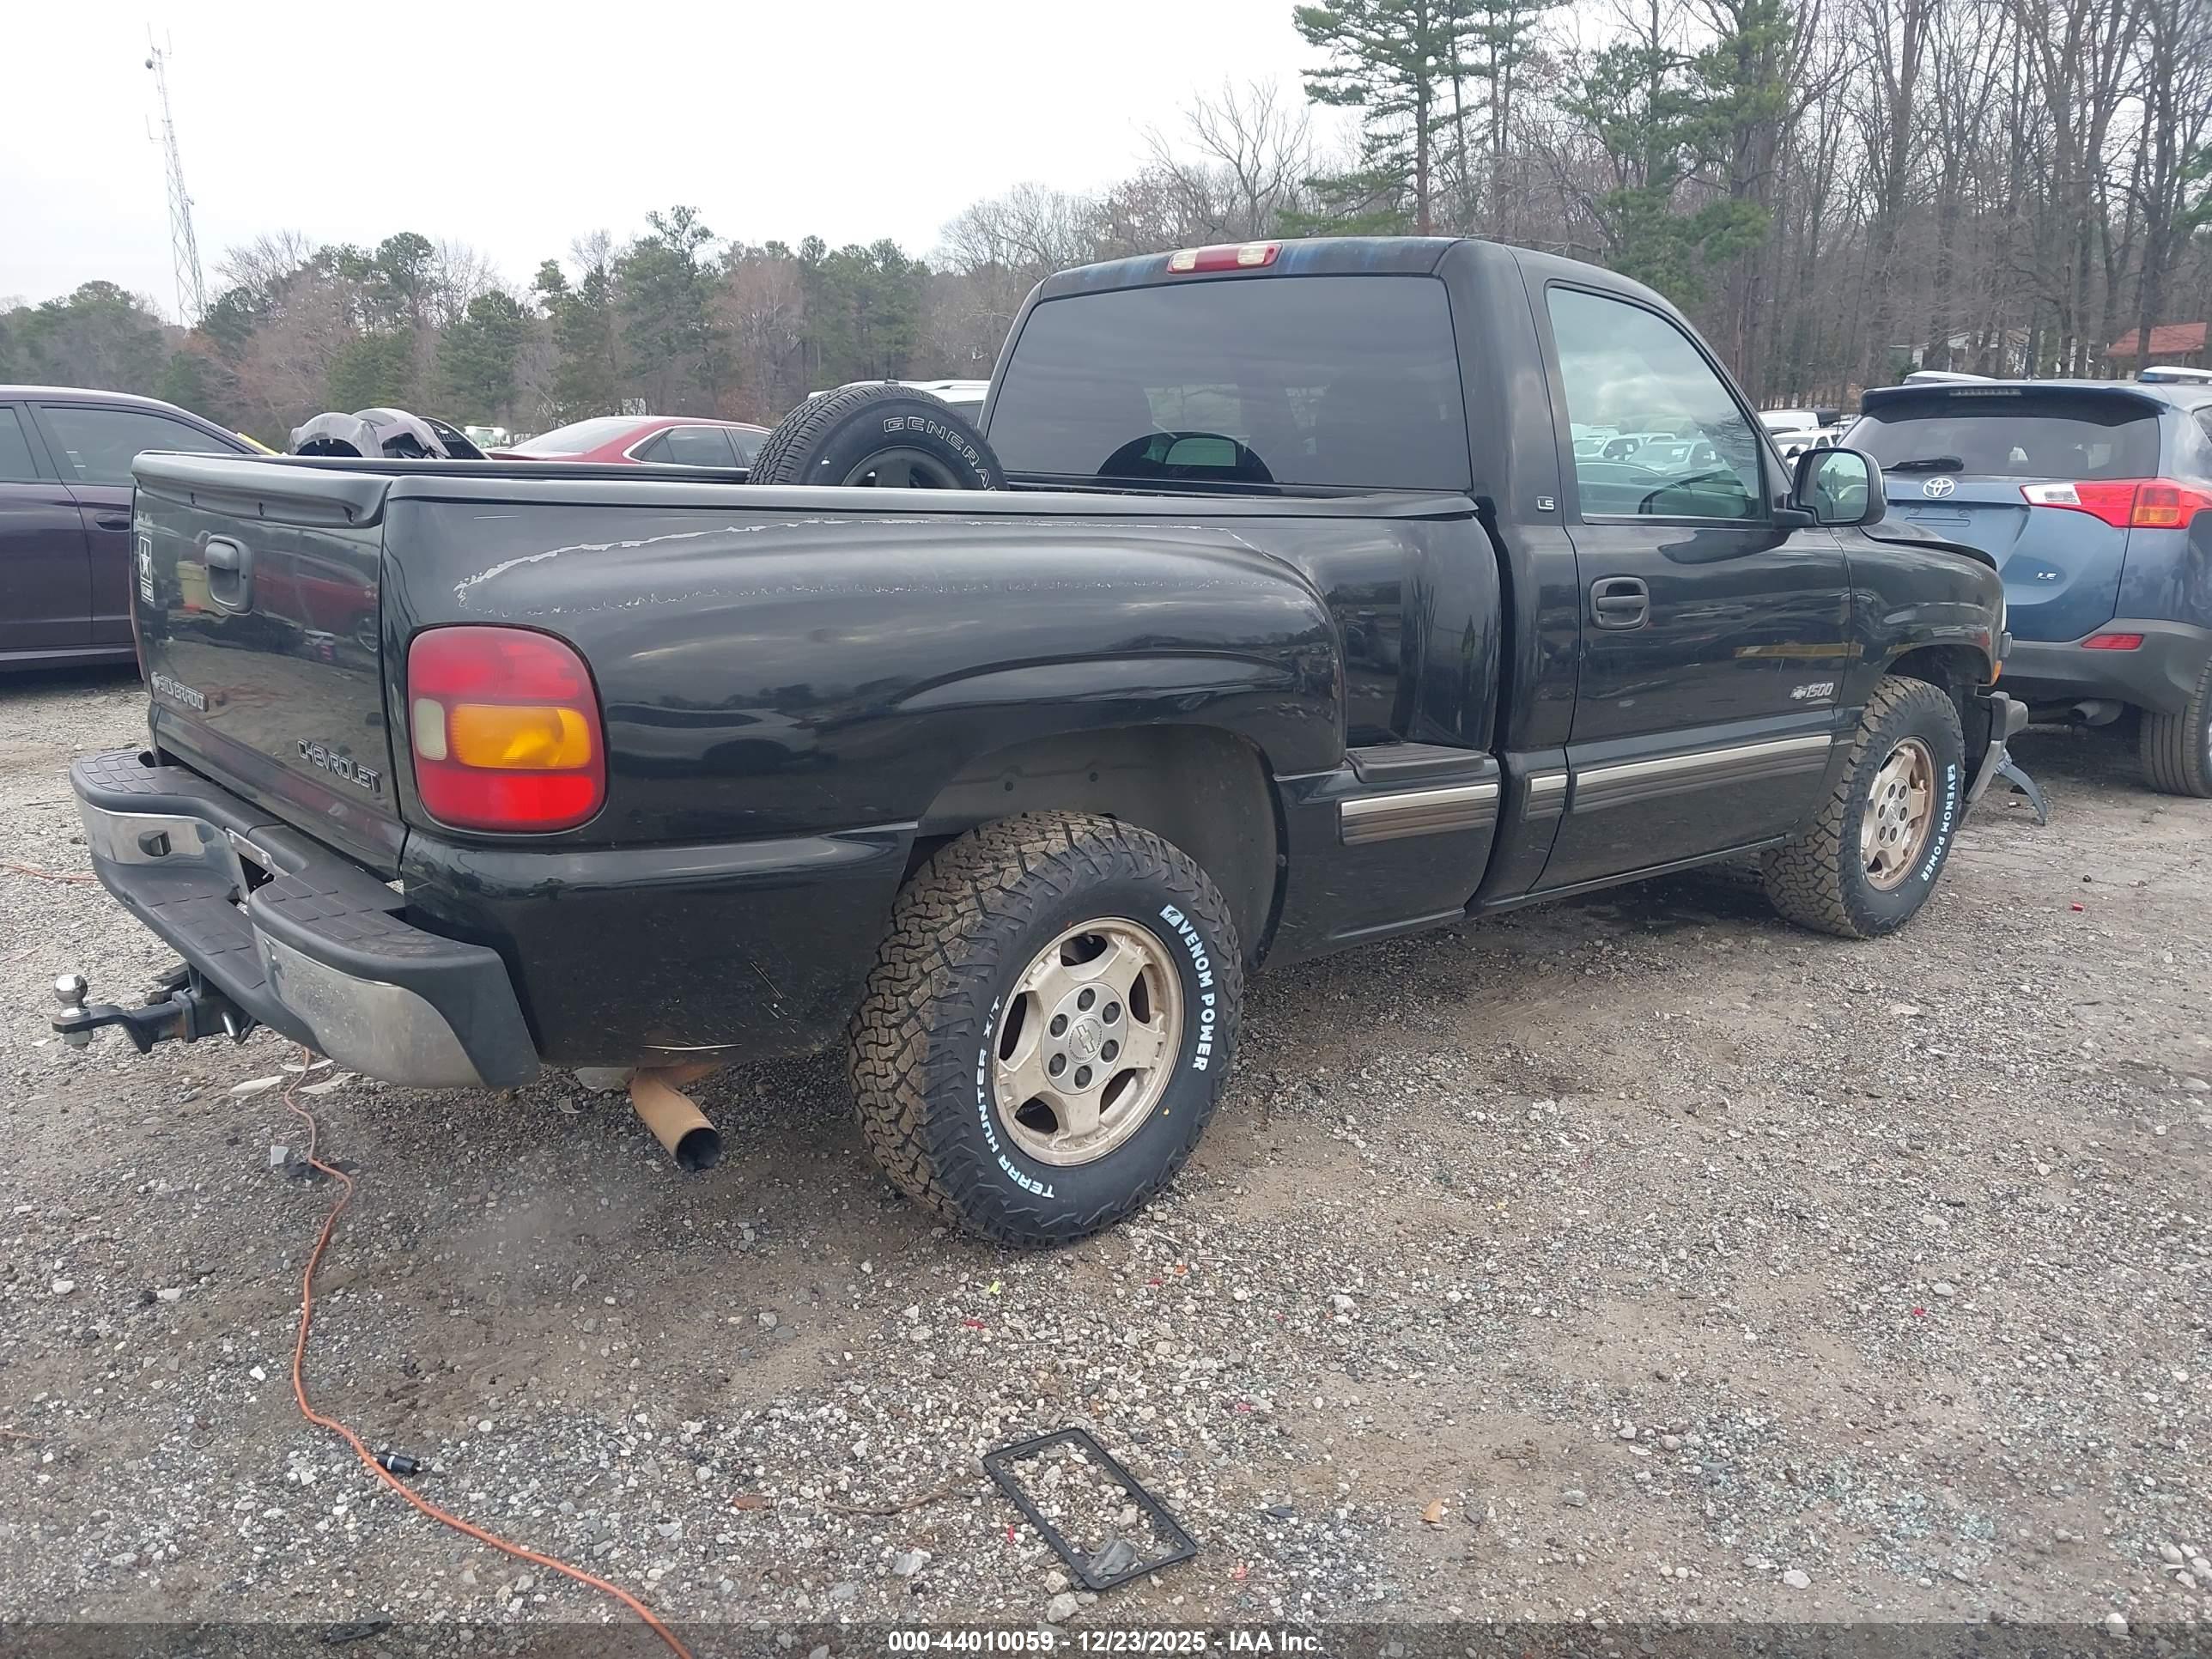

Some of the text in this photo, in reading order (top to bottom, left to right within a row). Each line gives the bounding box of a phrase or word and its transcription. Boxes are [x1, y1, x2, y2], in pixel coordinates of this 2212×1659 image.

[884, 416, 997, 492] GENERA
[1537, 496, 1555, 511] LS
[1805, 682, 1835, 698] 1500
[296, 738, 382, 792] CHEVROLET
[1920, 781, 1956, 882] VENOM POWER
[1177, 919, 1216, 1072] VENOM POWER
[975, 1048, 1000, 1153] HUNTER
[997, 1153, 1055, 1199] TERRA
